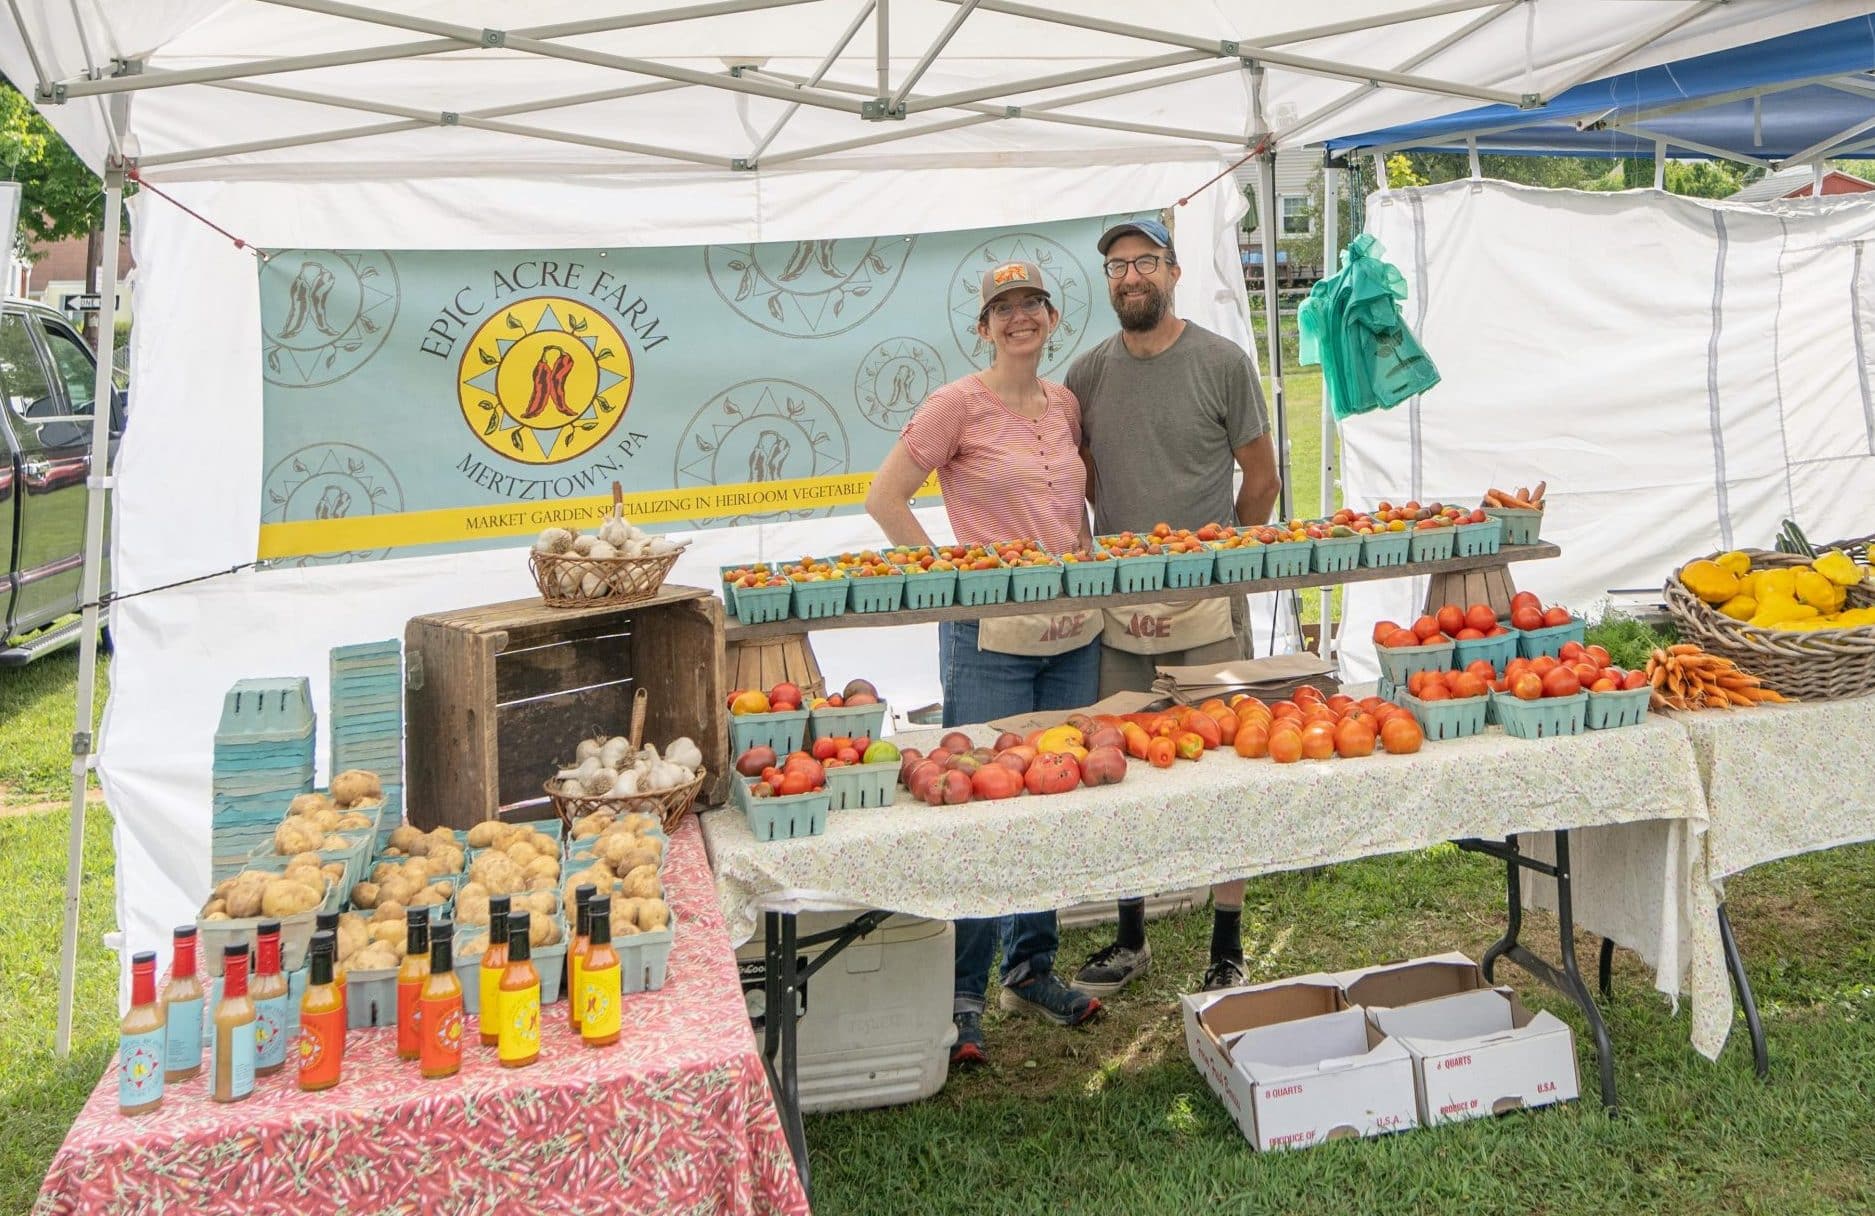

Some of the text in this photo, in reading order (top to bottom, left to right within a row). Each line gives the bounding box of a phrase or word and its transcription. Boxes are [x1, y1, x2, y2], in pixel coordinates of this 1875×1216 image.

[80, 298, 94, 307] ONE
[420, 261, 670, 361] EPIC ACRE FARM
[455, 430, 649, 500] MERTZTOWN, PA
[465, 513, 527, 531] MARKET
[530, 506, 593, 525] GARDEN
[597, 497, 691, 519] SPCIALIZING
[695, 496, 711, 510] IN
[715, 490, 789, 507] HEIRLOOM
[792, 483, 865, 501] VEGETABLE
[1039, 613, 1086, 641] ACE
[1124, 612, 1173, 638] ACE
[1444, 1055, 1472, 1069] QUARTS
[1265, 1085, 1303, 1099] 8 QUARTS
[1537, 1082, 1557, 1094] U.S.A.
[1439, 1099, 1478, 1115] PRODUCE OF
[1376, 1115, 1402, 1127] U.S.A.
[1305, 1130, 1316, 1140] OF
